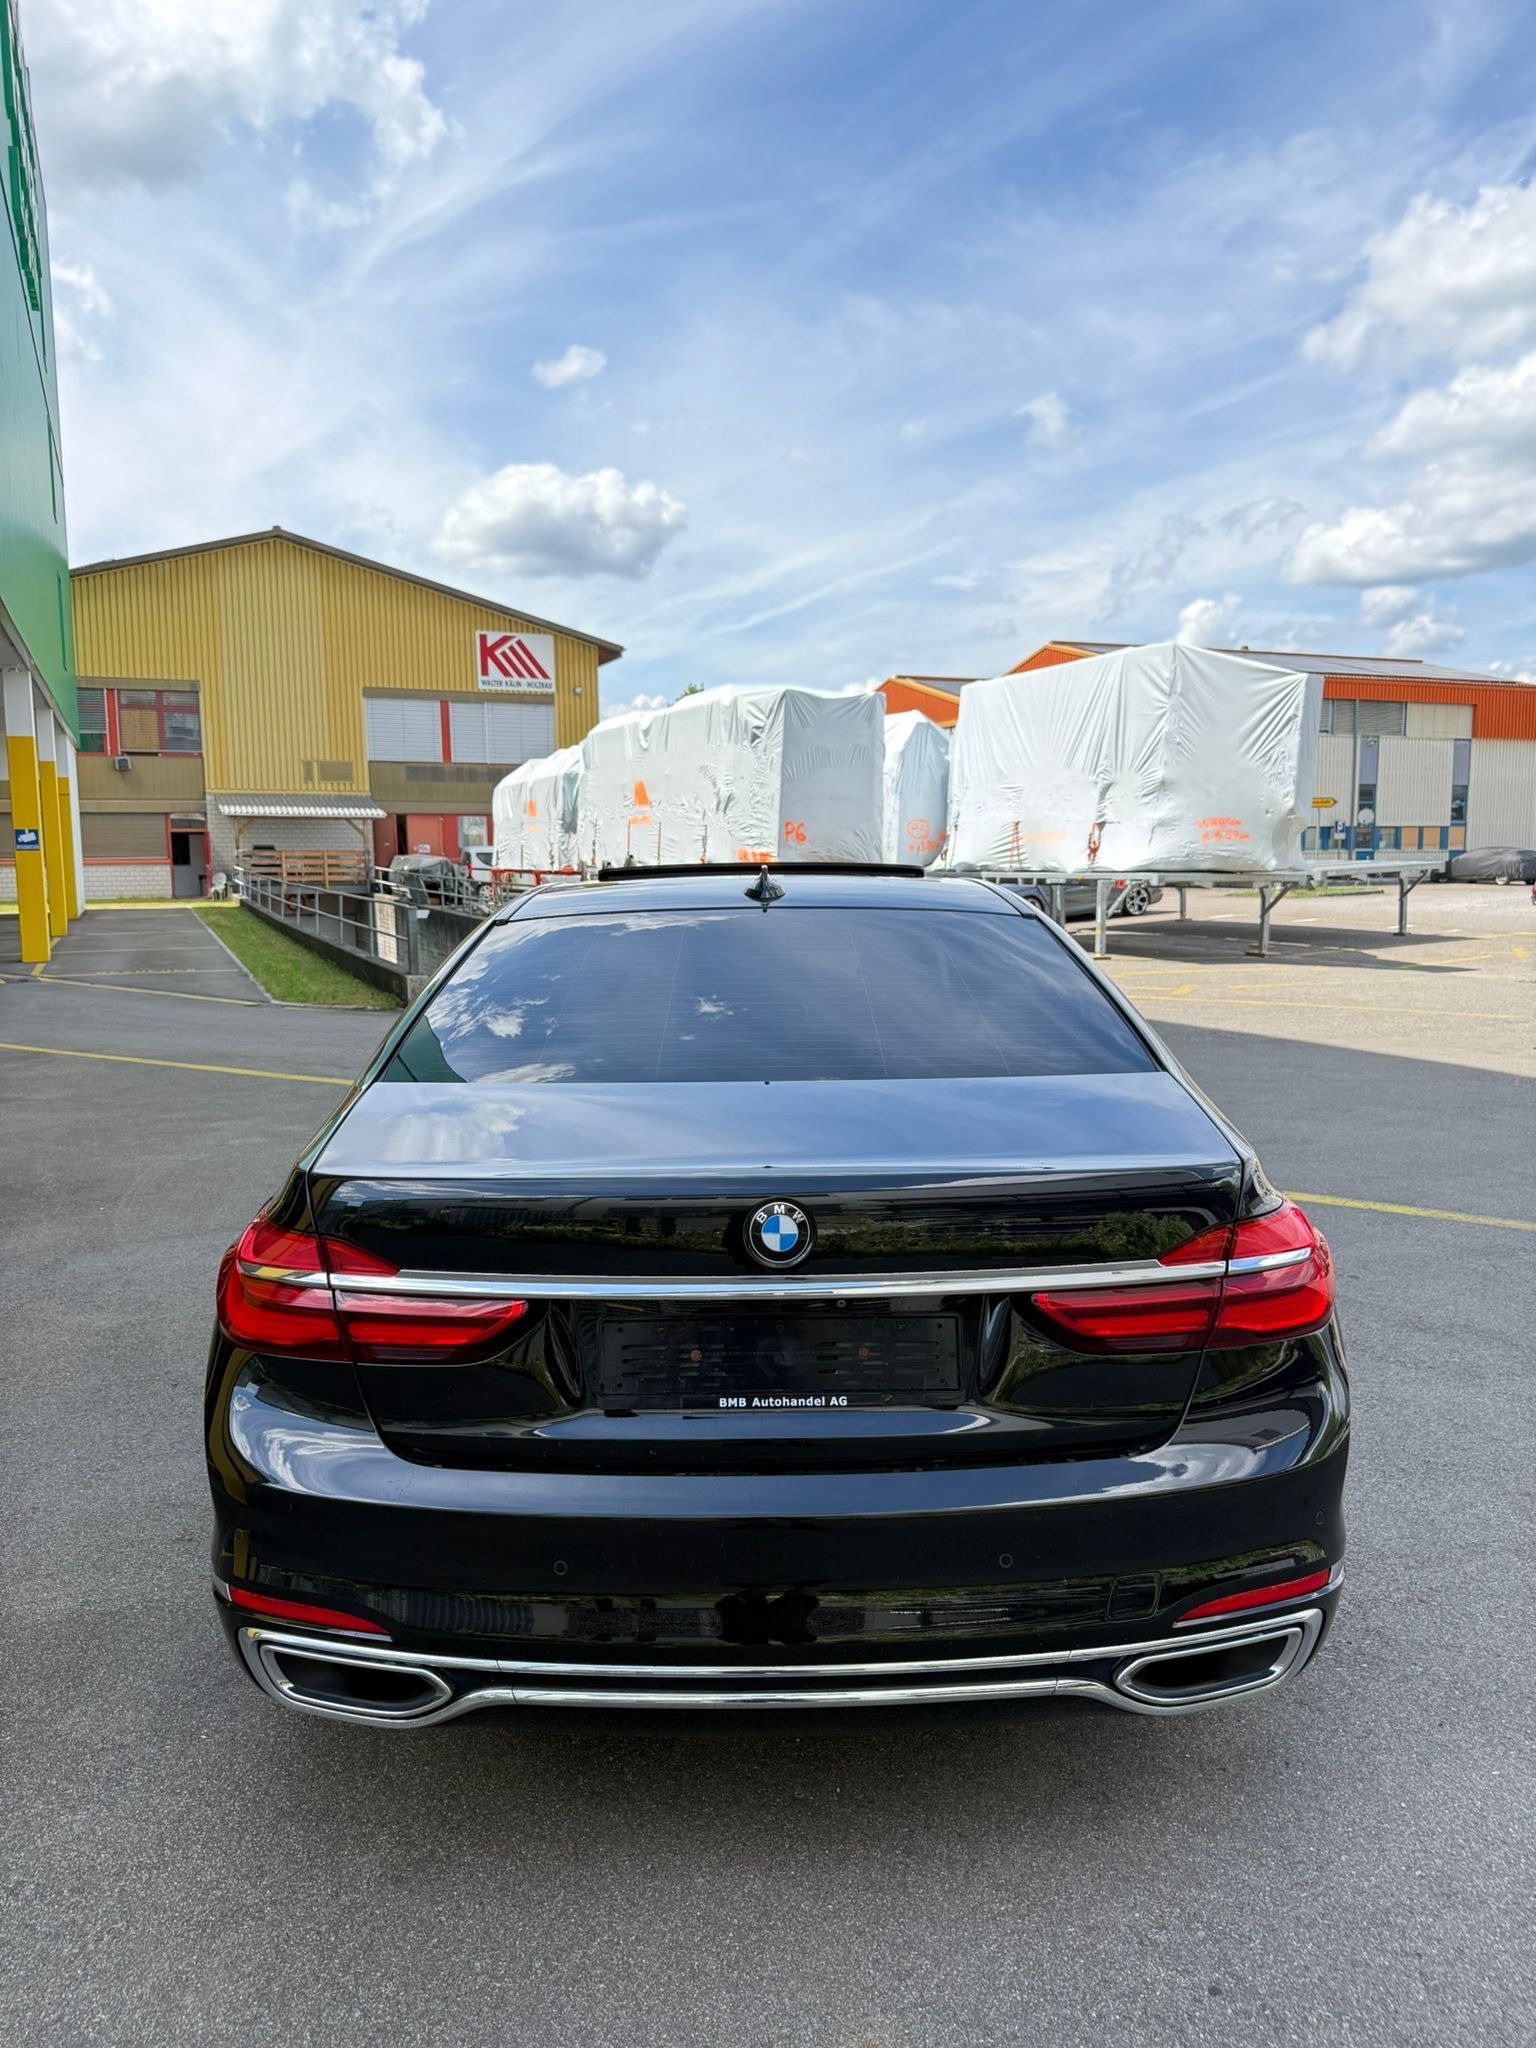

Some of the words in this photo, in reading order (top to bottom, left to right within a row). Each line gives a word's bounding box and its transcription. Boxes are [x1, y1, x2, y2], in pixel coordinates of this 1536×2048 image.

[481, 679, 503, 688] WALTER
[526, 681, 553, 690] HOLZBAU
[784, 821, 807, 843] P6
[755, 1204, 805, 1225] BMW
[719, 1397, 747, 1408] BMB
[751, 1396, 826, 1407] Autohandel
[829, 1396, 848, 1407] AG
